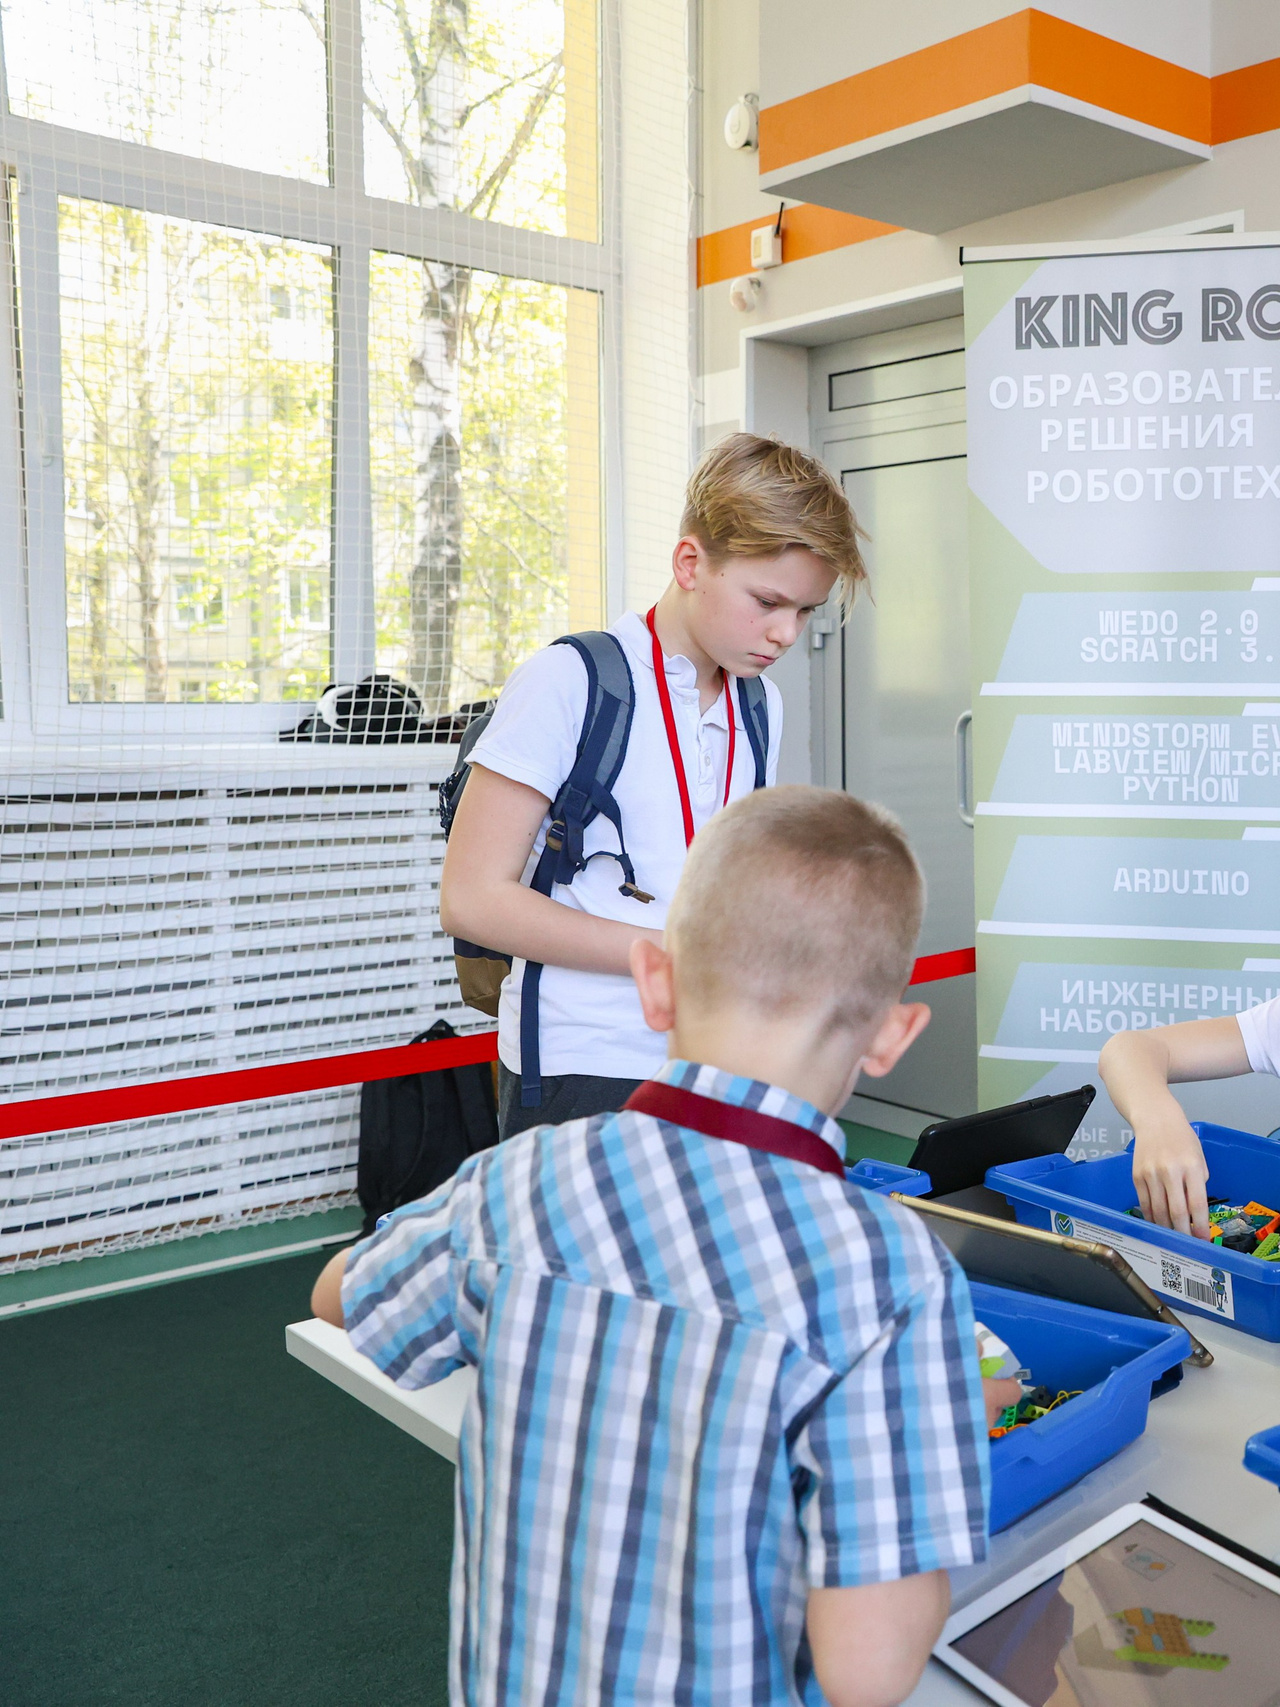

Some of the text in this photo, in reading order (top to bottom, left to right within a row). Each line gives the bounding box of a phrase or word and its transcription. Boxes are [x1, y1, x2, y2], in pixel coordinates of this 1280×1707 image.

[1015, 289, 1183, 350] KING
[1040, 413, 1254, 452] РЕШЕНИЯ
[1099, 609, 1259, 635] WEDO 2.0
[1080, 637, 1217, 663] SCRATCH
[1052, 722, 1230, 748] MINDSTORM
[1123, 776, 1239, 802] PYTHON
[1113, 867, 1250, 896] ARDUINO
